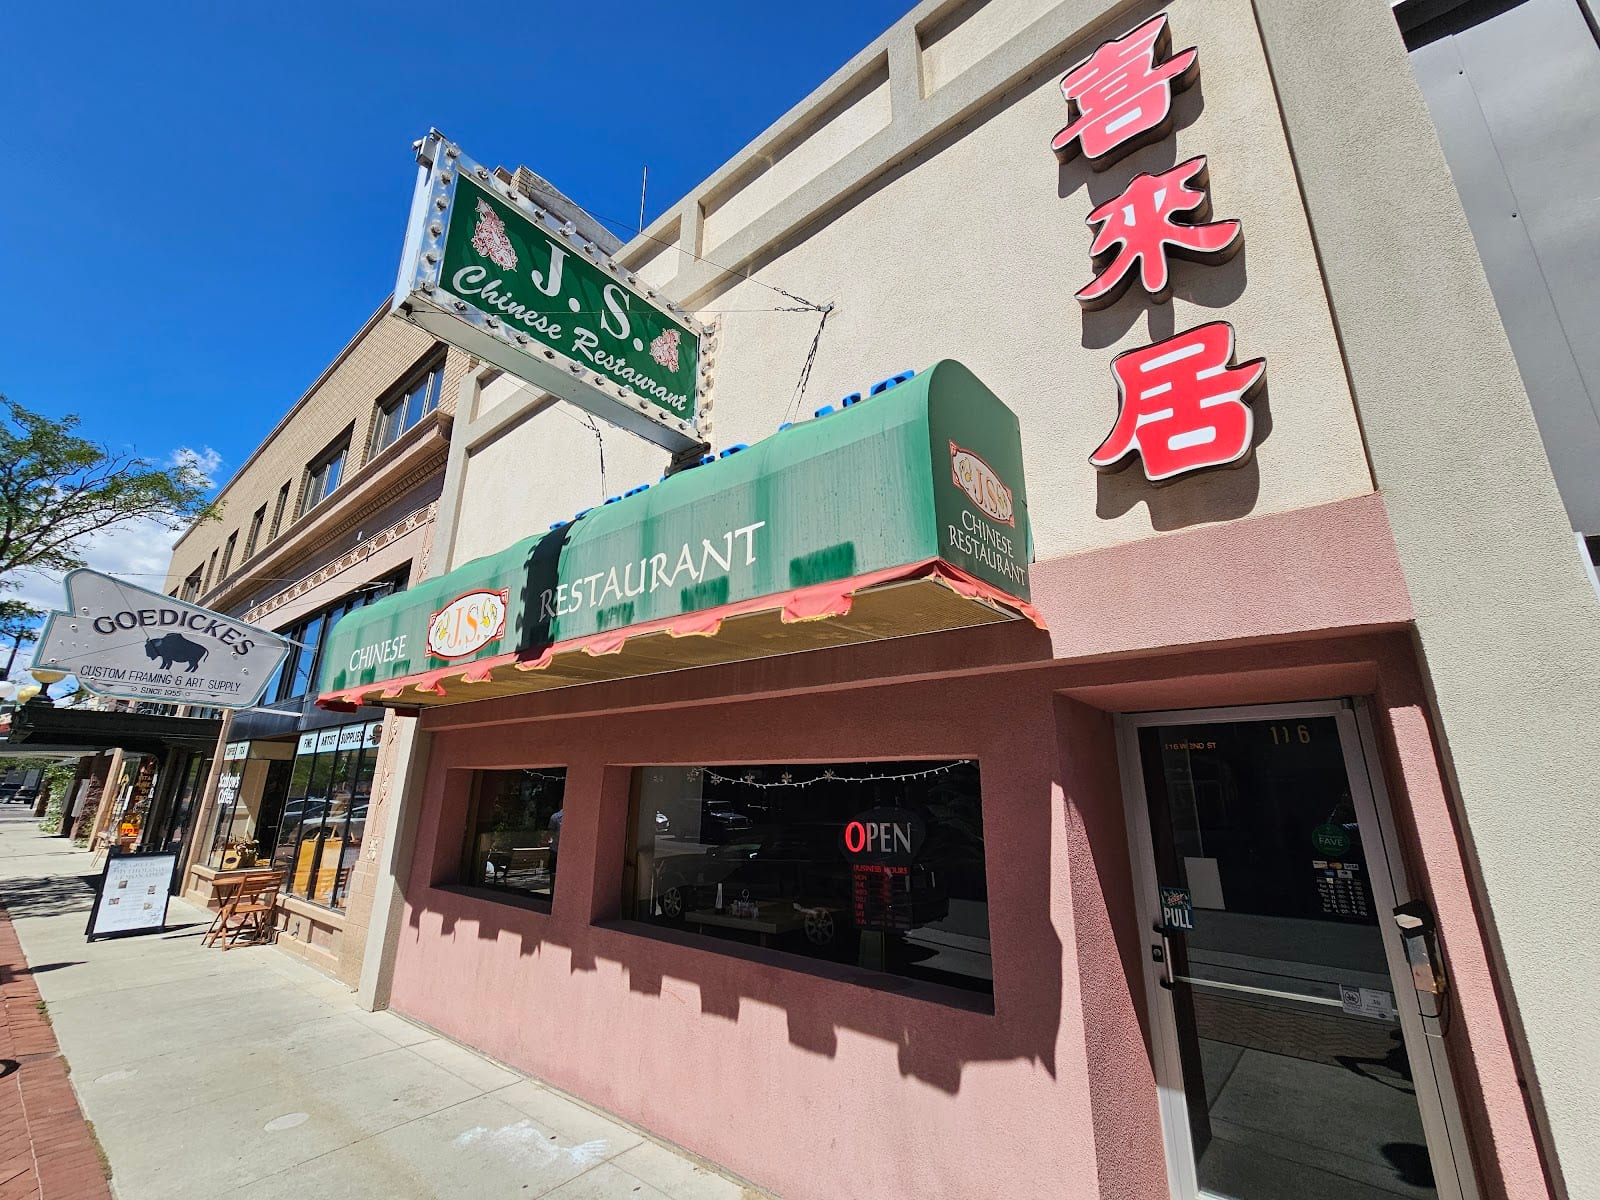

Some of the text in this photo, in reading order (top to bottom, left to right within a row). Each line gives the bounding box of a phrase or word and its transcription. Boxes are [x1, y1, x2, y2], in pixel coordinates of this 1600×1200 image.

[1050, 13, 1267, 482] 喜來居
[452, 265, 686, 411] Chinese Restaurant
[961, 510, 1014, 558] CHINESE
[538, 521, 765, 622] RESTAURANT
[949, 525, 1026, 586] RESTAURANT
[93, 609, 255, 656] GOEDICKE'S
[350, 635, 408, 672] CHINESE
[80, 665, 241, 692] CUSTOM FRAMING & ART SUPPLY
[140, 687, 182, 697] SINCE 1955
[303, 730, 364, 749] FINE ARTIST SUPPLIES
[1270, 725, 1311, 745] 116
[845, 821, 912, 854] OPEN
[1318, 837, 1345, 847] FAVE
[853, 864, 881, 873] BUSINESS
[1163, 907, 1193, 929] PULL
